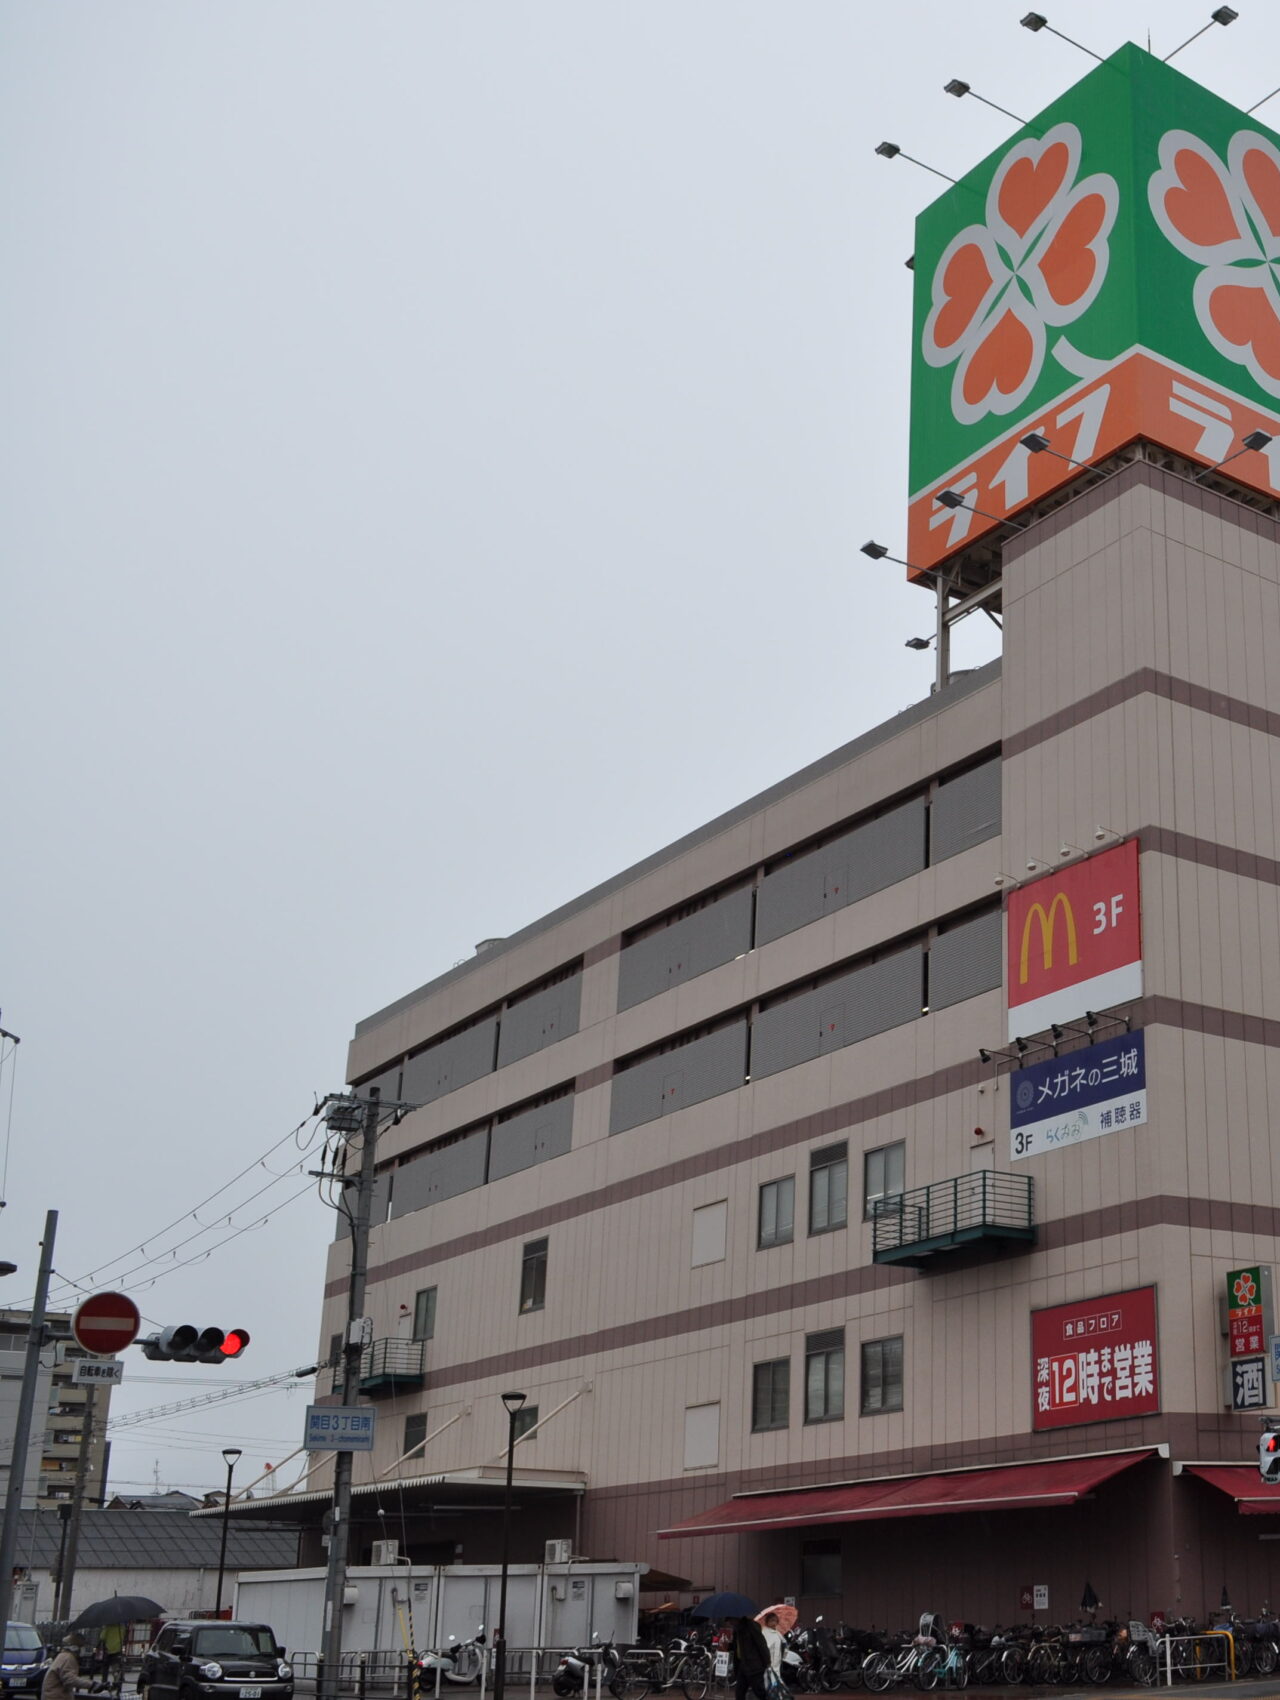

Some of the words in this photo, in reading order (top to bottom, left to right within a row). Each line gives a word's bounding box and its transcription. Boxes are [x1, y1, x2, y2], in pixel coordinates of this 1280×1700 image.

[929, 384, 1111, 549] ライフ
[1092, 894, 1124, 935] 3F
[1037, 1048, 1138, 1104] メガネの三城
[1015, 1132, 1033, 1155] 3F
[1100, 1101, 1141, 1129] 補聴器
[1065, 1314, 1119, 1336] 食品フロア
[1235, 1306, 1256, 1318] ライフ
[1235, 1335, 1260, 1353] 営業
[80, 1365, 120, 1378] 自転車を除く
[1235, 1361, 1264, 1406] 酒
[310, 1414, 371, 1431] 関目3丁目南
